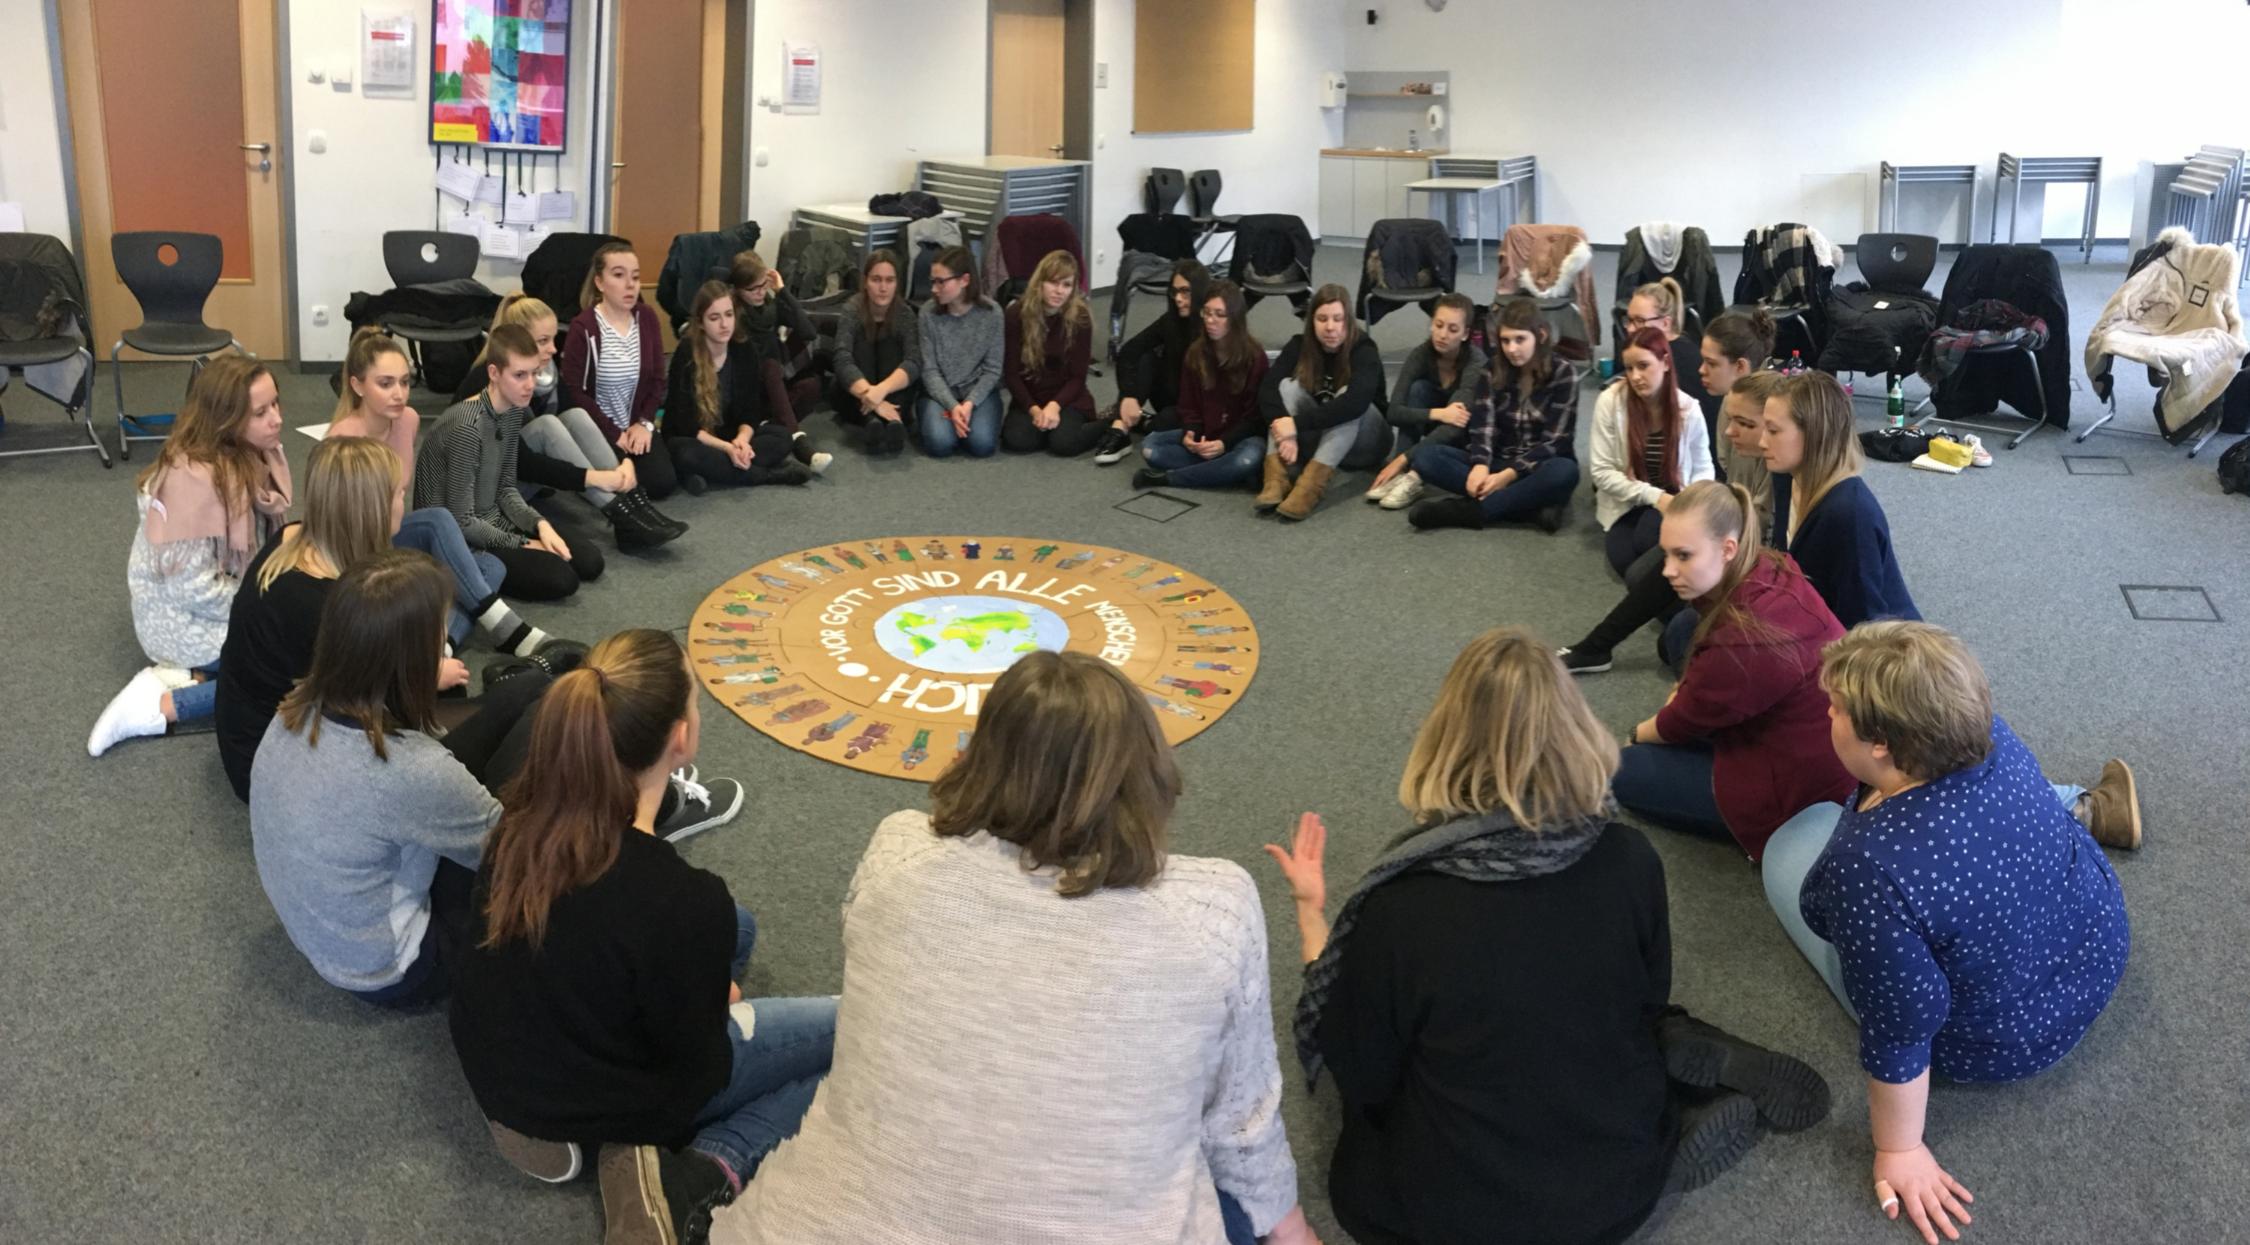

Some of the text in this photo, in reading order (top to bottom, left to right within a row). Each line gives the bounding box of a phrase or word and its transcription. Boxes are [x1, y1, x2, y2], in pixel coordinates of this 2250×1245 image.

[872, 571, 961, 596] SIND
[974, 570, 1097, 605] ALLE
[819, 588, 873, 625] GOTT
[820, 629, 852, 656] VOR
[877, 673, 994, 716] ICH
